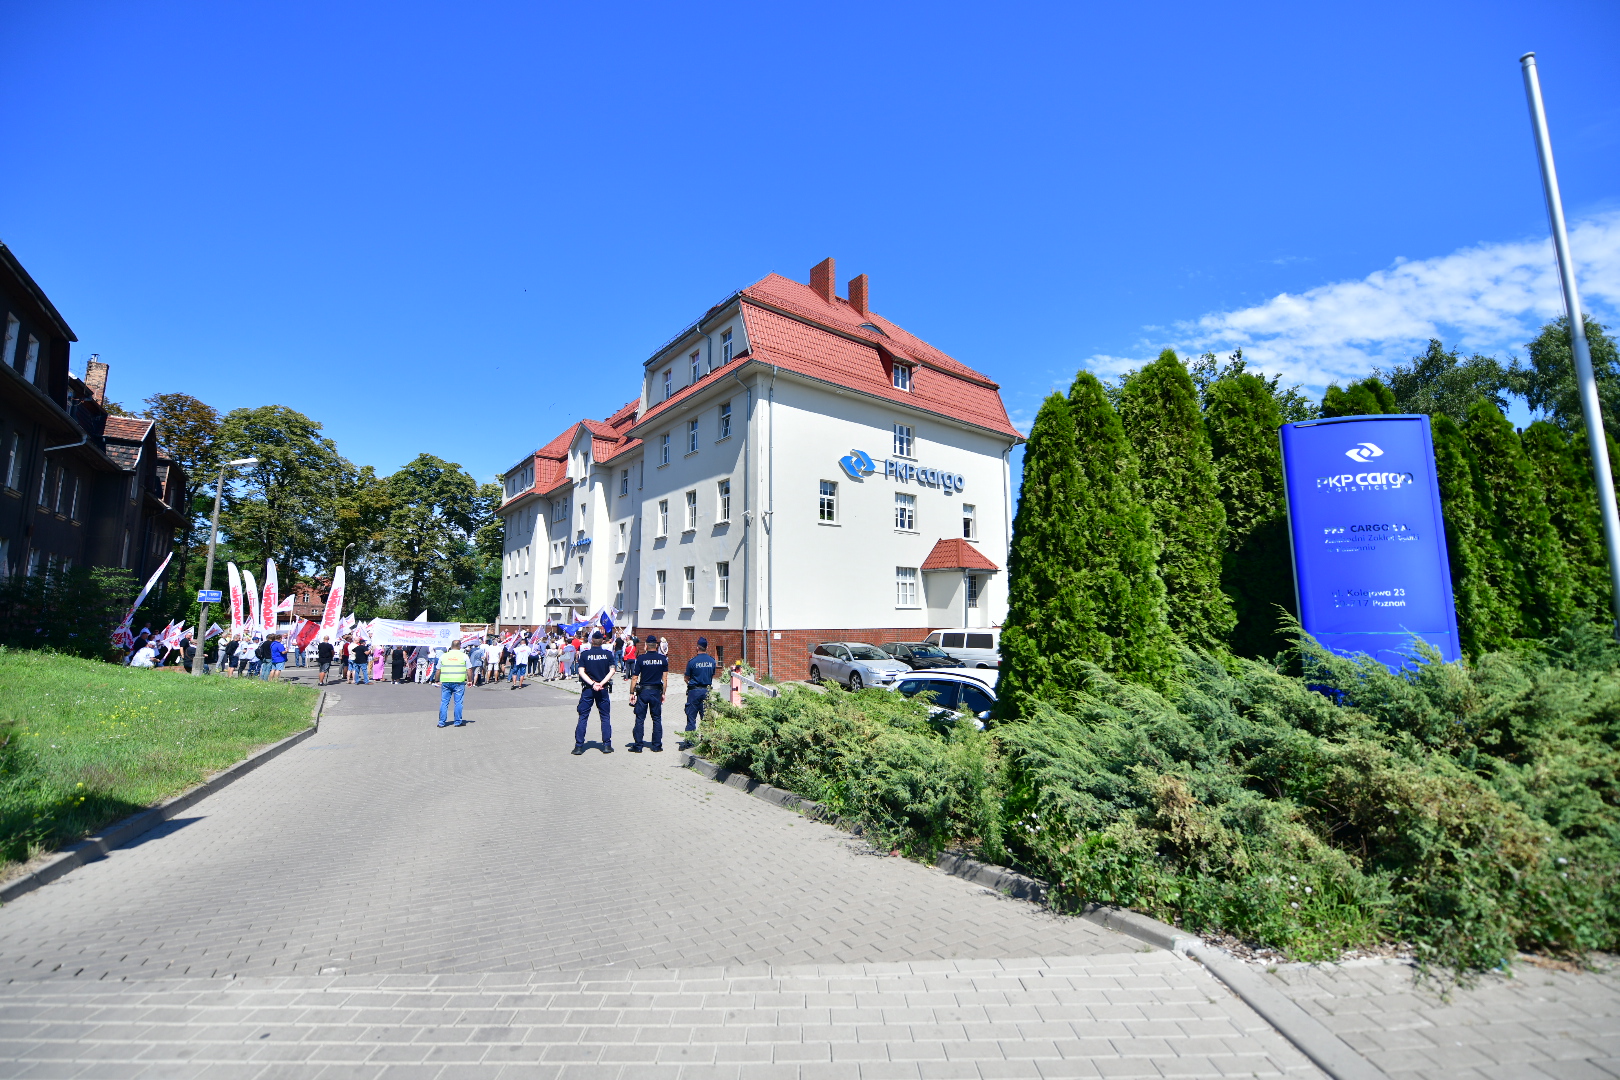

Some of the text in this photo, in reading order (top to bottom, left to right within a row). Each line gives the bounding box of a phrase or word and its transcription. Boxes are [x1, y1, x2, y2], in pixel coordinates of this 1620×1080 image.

[885, 458, 965, 492] PKP cargo
[1316, 472, 1414, 489] PKP cargo
[1350, 523, 1389, 533] CARGO
[1392, 523, 1412, 532] SA.
[1346, 588, 1392, 599] Kolejowa
[1393, 588, 1406, 597] 23
[1372, 599, 1407, 607] Poznań
